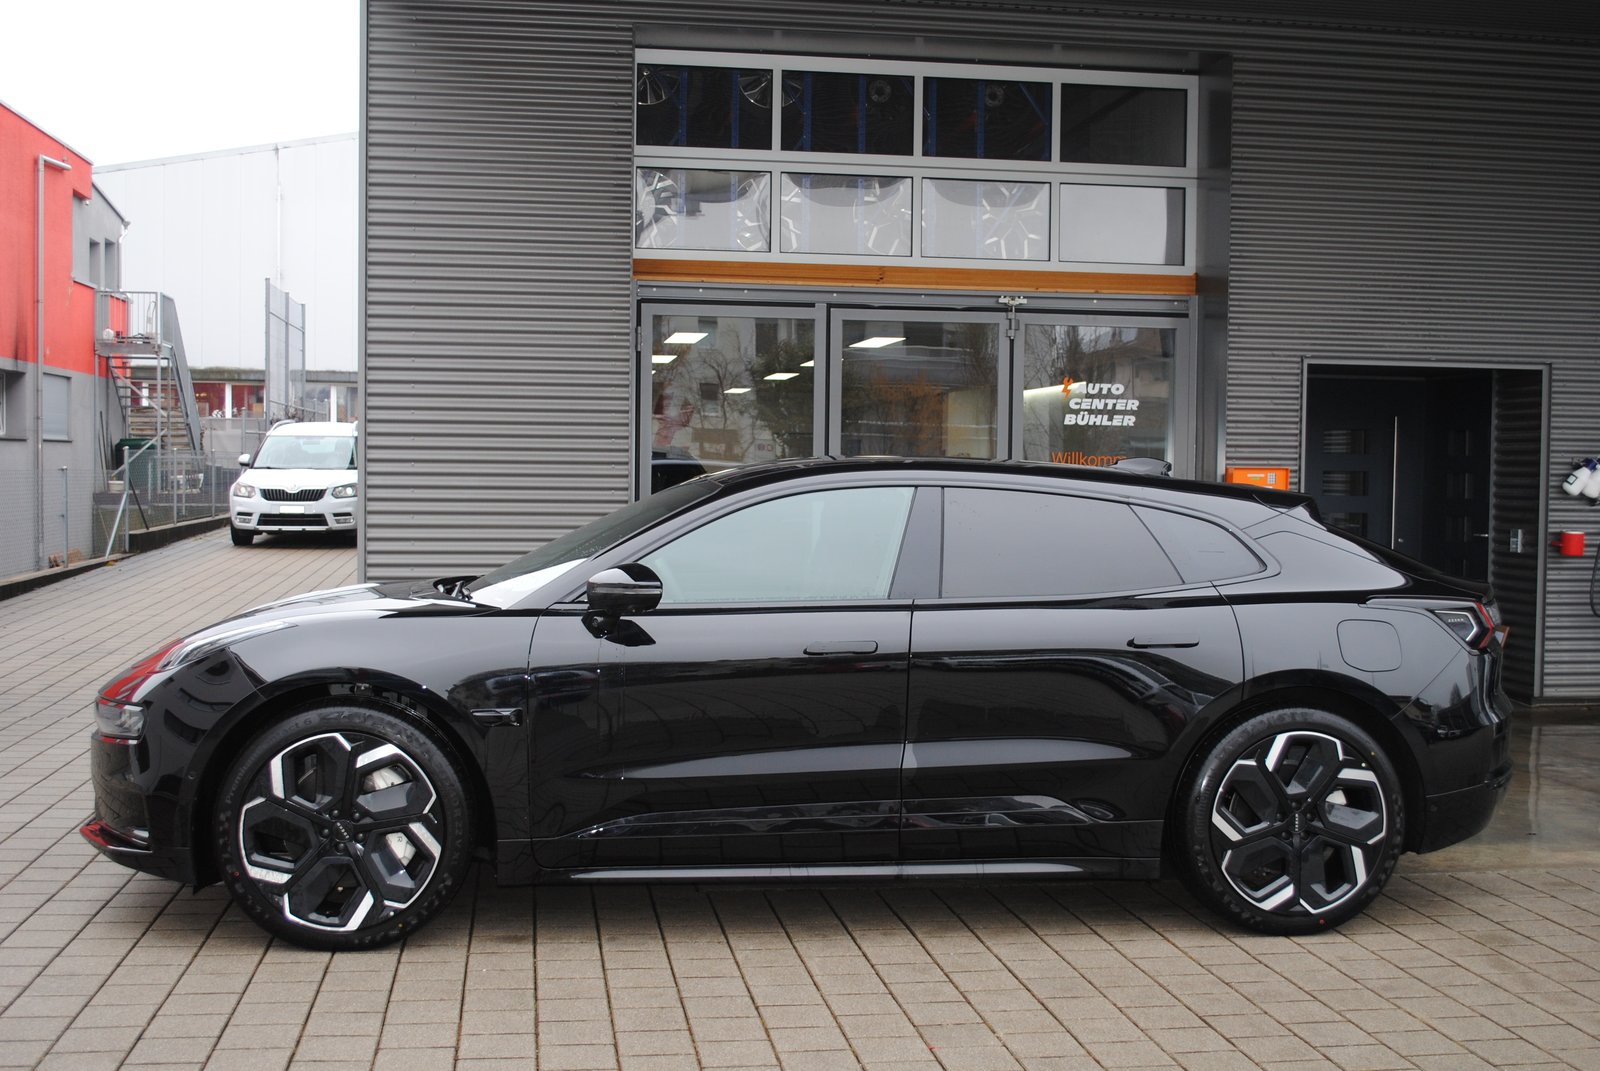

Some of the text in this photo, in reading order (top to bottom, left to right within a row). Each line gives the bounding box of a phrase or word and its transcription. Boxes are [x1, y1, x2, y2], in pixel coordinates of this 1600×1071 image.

[1075, 383, 1125, 395] AUTO
[1068, 398, 1140, 411] CENTER
[1063, 411, 1137, 427] BÜHLER
